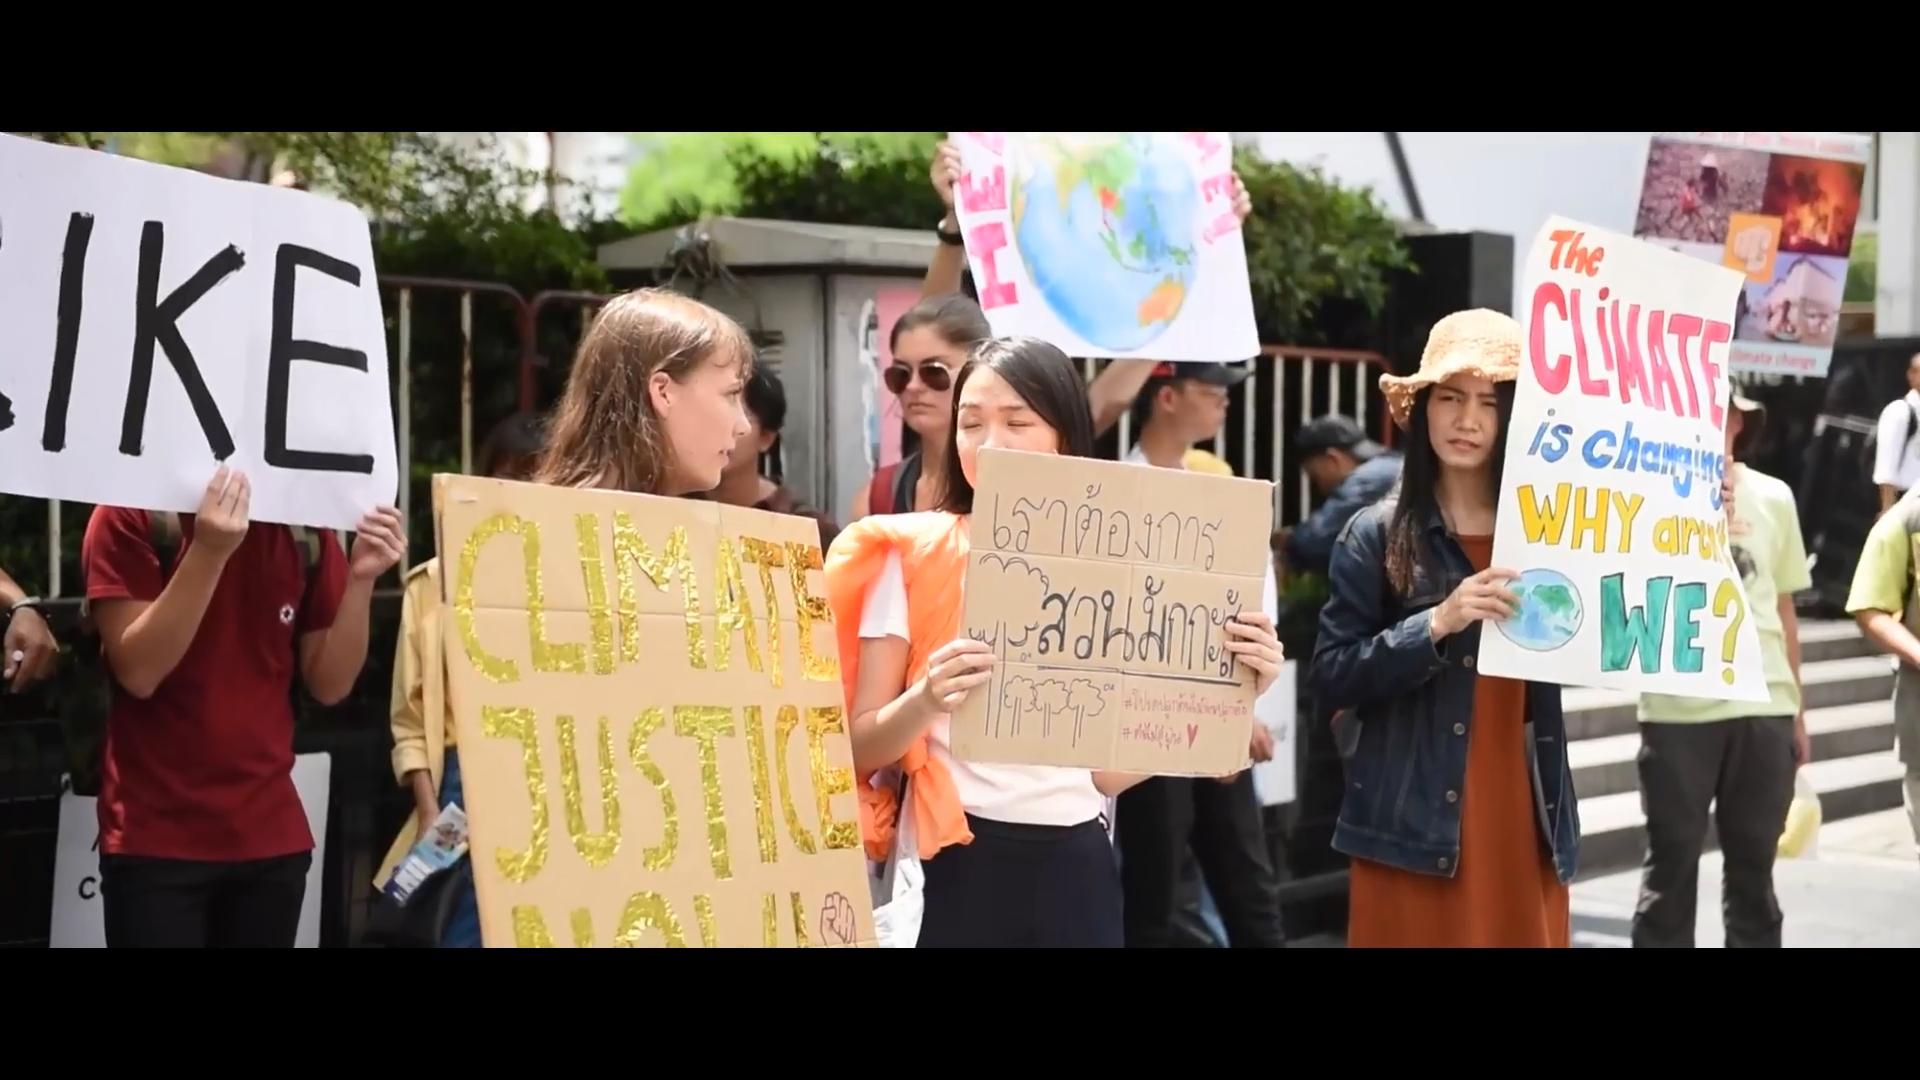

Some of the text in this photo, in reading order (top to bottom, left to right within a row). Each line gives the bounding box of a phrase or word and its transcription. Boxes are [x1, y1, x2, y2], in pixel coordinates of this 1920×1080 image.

[1549, 230, 1604, 277] The
[0, 208, 374, 474] IKE
[1528, 408, 1573, 463] is
[992, 483, 1222, 571] เราต้องการ
[1517, 483, 1645, 554] WHY
[454, 510, 837, 688] CLIMATE
[1600, 572, 1747, 685] WE?
[482, 704, 861, 884] JUSTICE
